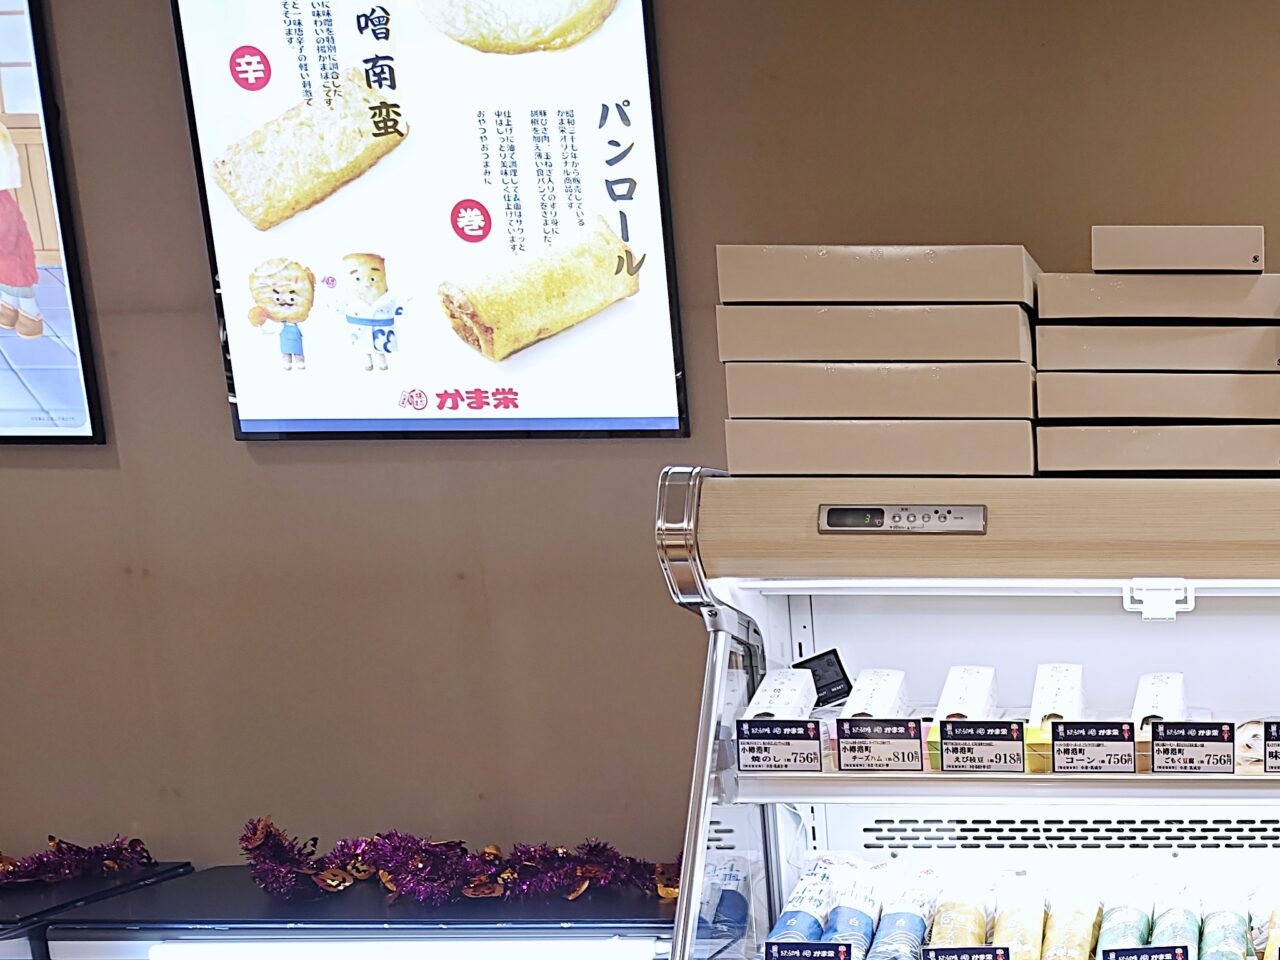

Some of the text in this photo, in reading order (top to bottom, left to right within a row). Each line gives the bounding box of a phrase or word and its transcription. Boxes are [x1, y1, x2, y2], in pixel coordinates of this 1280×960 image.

[235, 54, 265, 84] 辛
[356, 5, 405, 138] 噌南蛮
[598, 99, 647, 276] パンロール
[456, 207, 486, 236] 巻
[435, 387, 519, 411] かま栄
